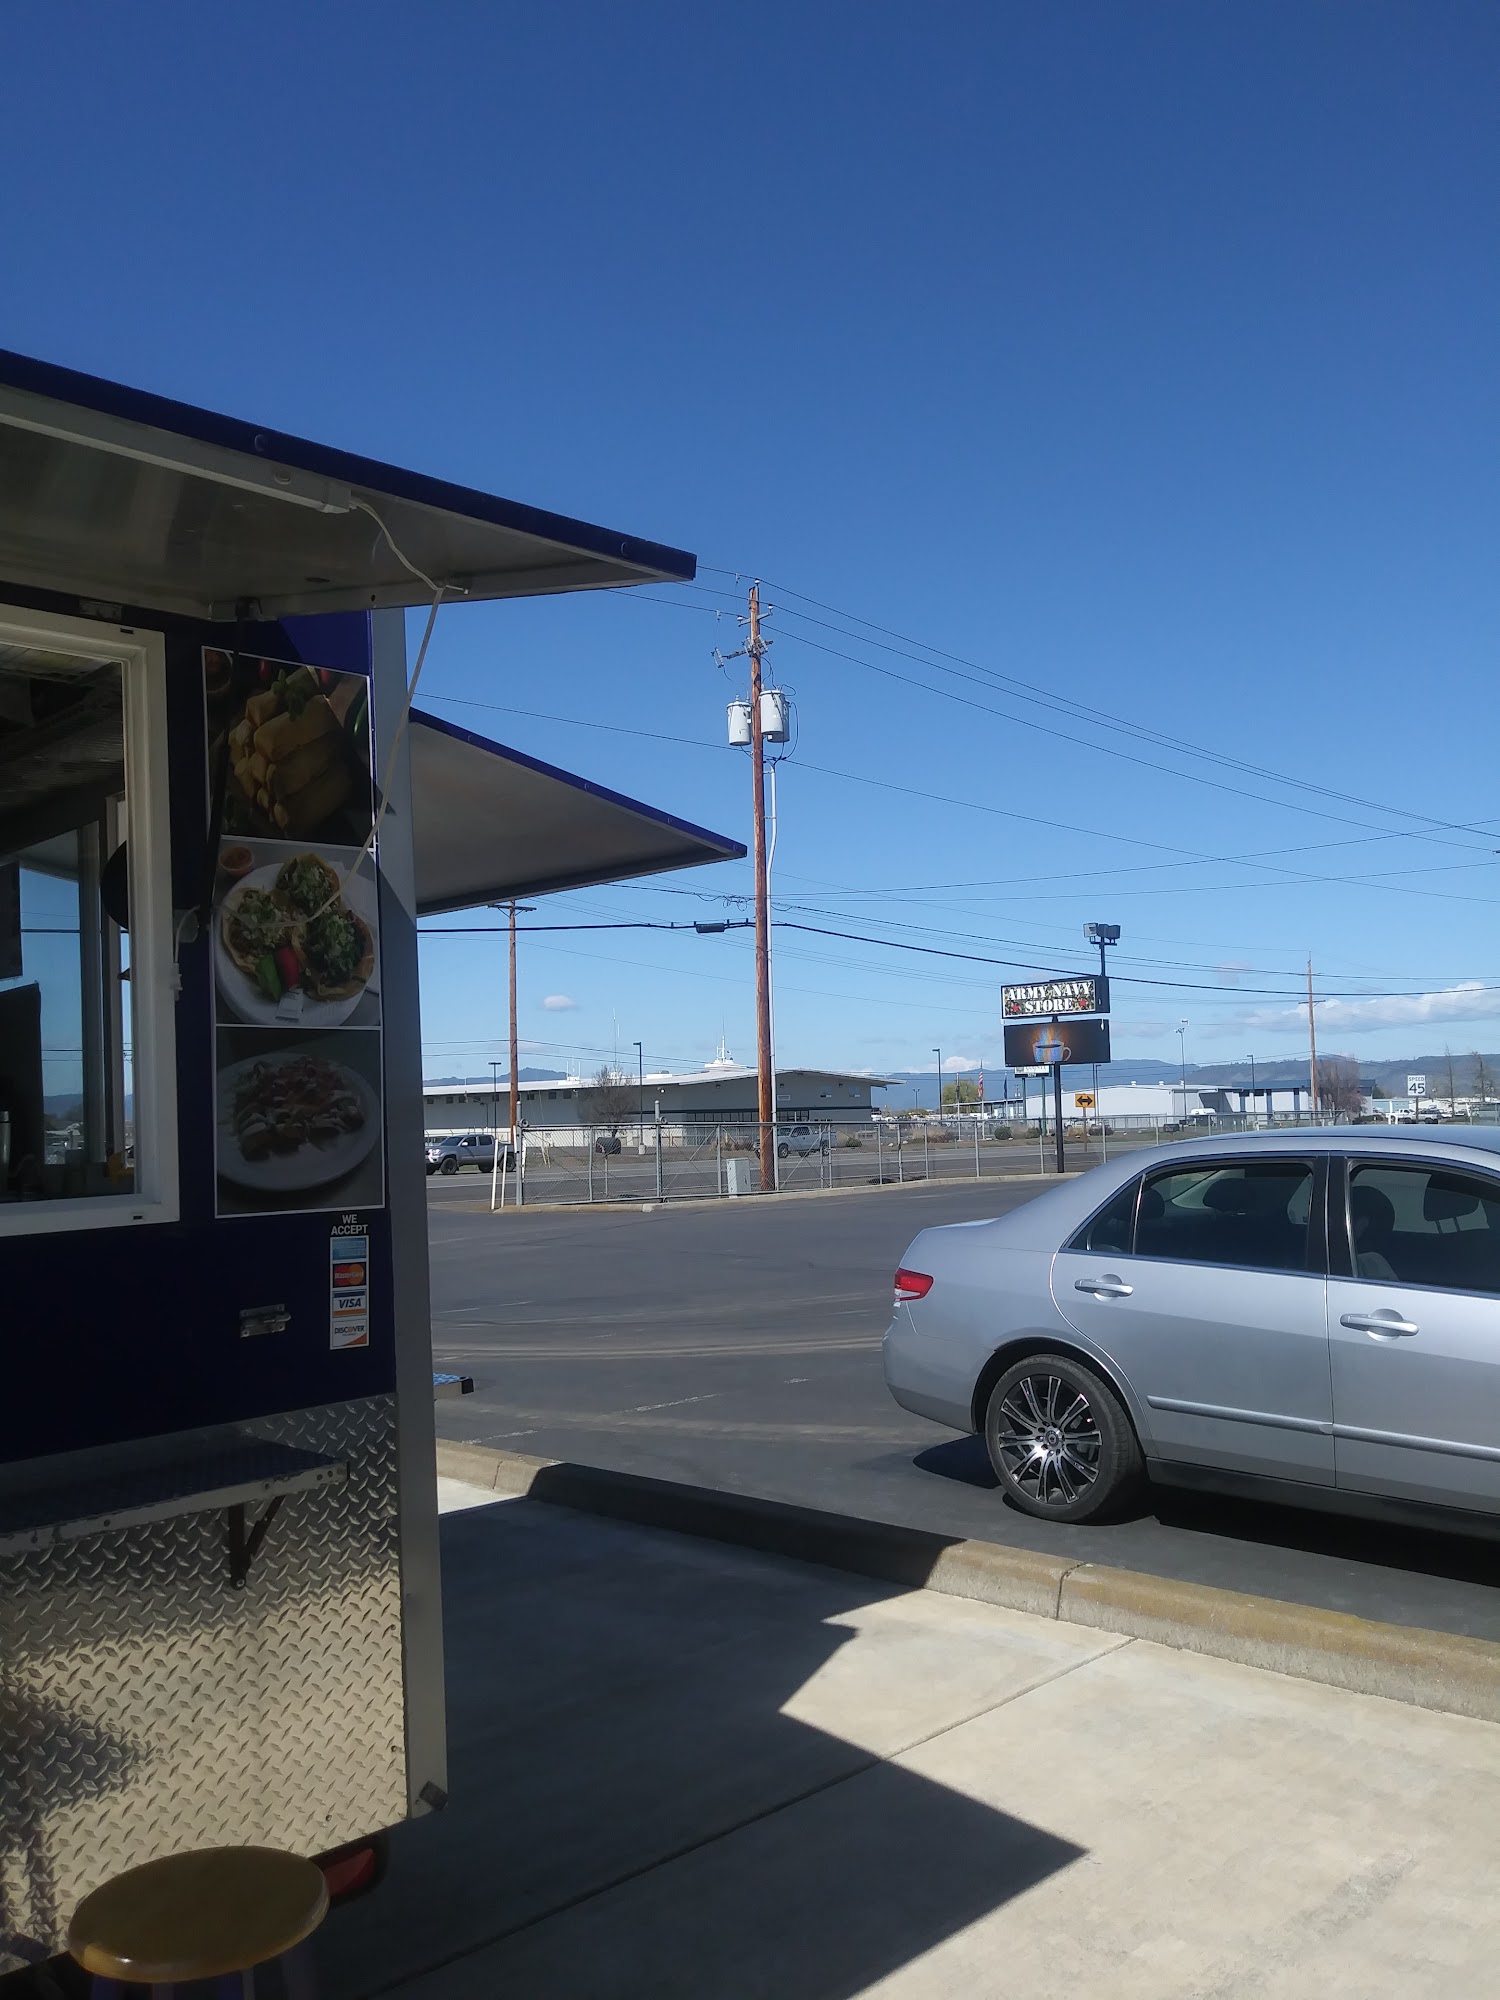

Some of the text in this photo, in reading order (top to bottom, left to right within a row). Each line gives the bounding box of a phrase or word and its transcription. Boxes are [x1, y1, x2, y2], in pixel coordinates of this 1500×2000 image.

[1007, 982, 1091, 1000] ARMY NAVY
[1025, 998, 1074, 1013] STORE
[1409, 1083, 1425, 1094] 45
[342, 1214, 357, 1224] WE
[331, 1224, 368, 1235] ACCEPT
[339, 1298, 361, 1308] VISA
[335, 1325, 364, 1334] DISCOVER
